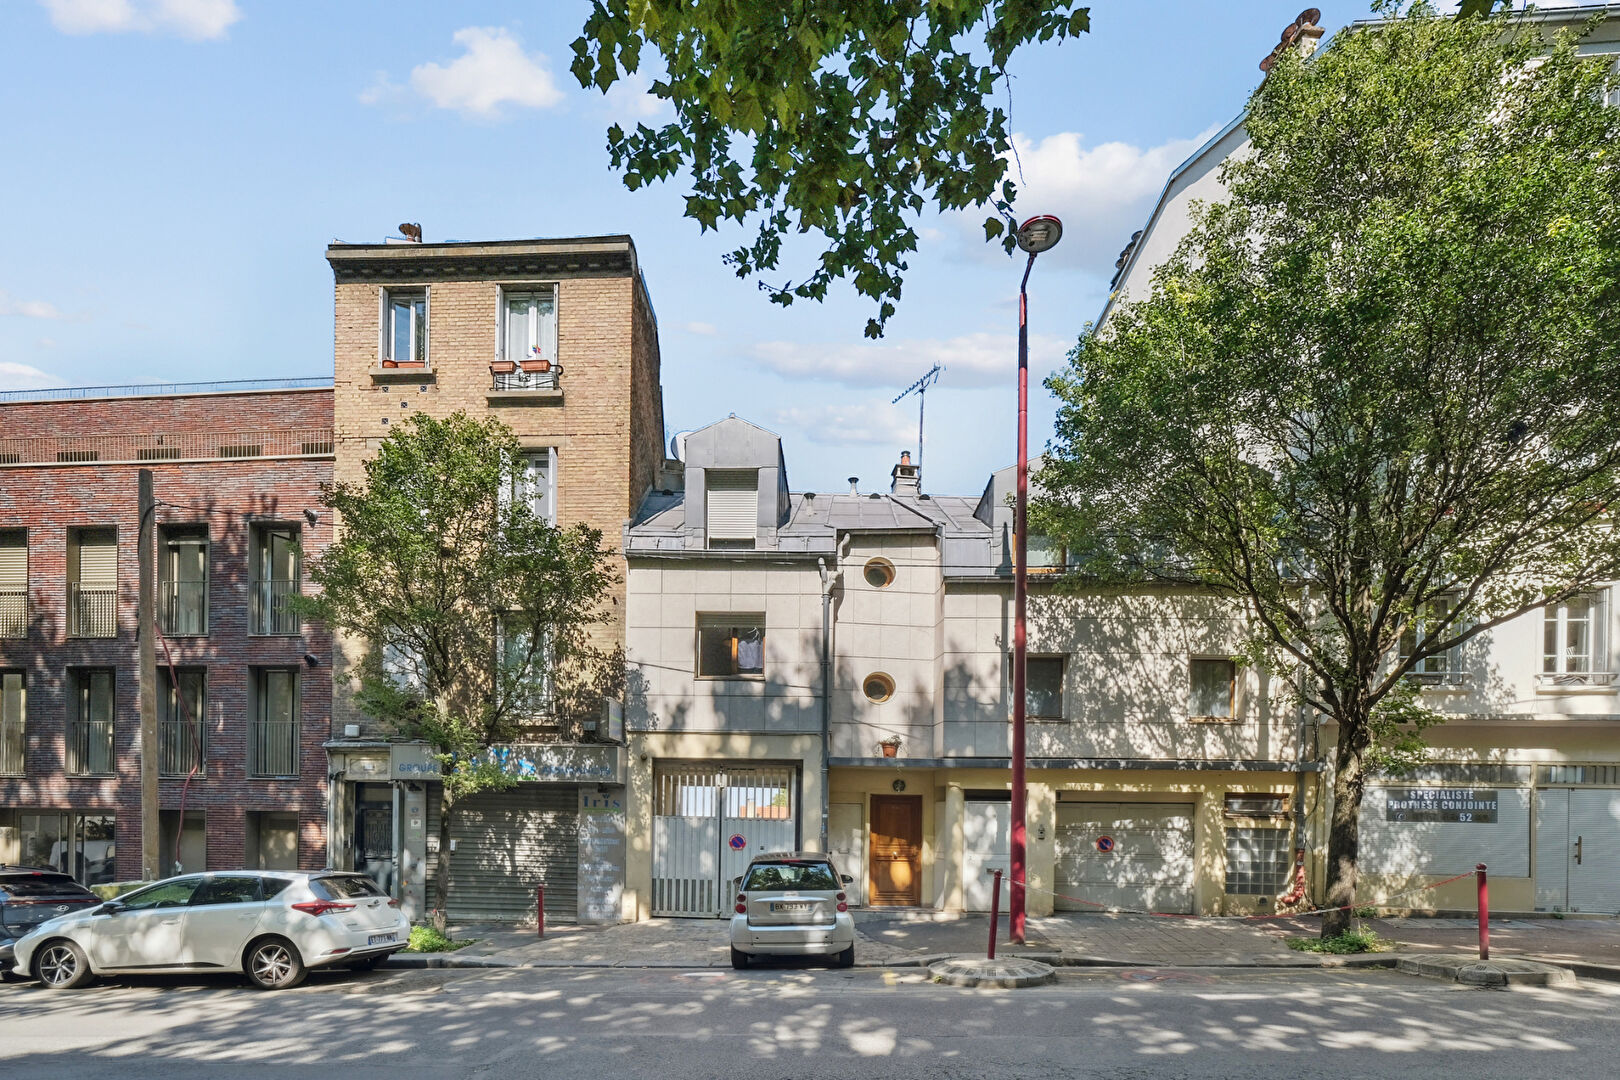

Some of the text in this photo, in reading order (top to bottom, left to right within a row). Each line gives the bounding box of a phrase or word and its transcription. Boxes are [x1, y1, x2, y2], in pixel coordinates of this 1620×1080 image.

[398, 763, 438, 772] GROUPE
[1410, 790, 1474, 800] SPECIALISTE
[583, 794, 621, 808] Iris
[1387, 800, 1497, 810] PROTHESE CONJOINTE
[1459, 812, 1473, 822] 52
